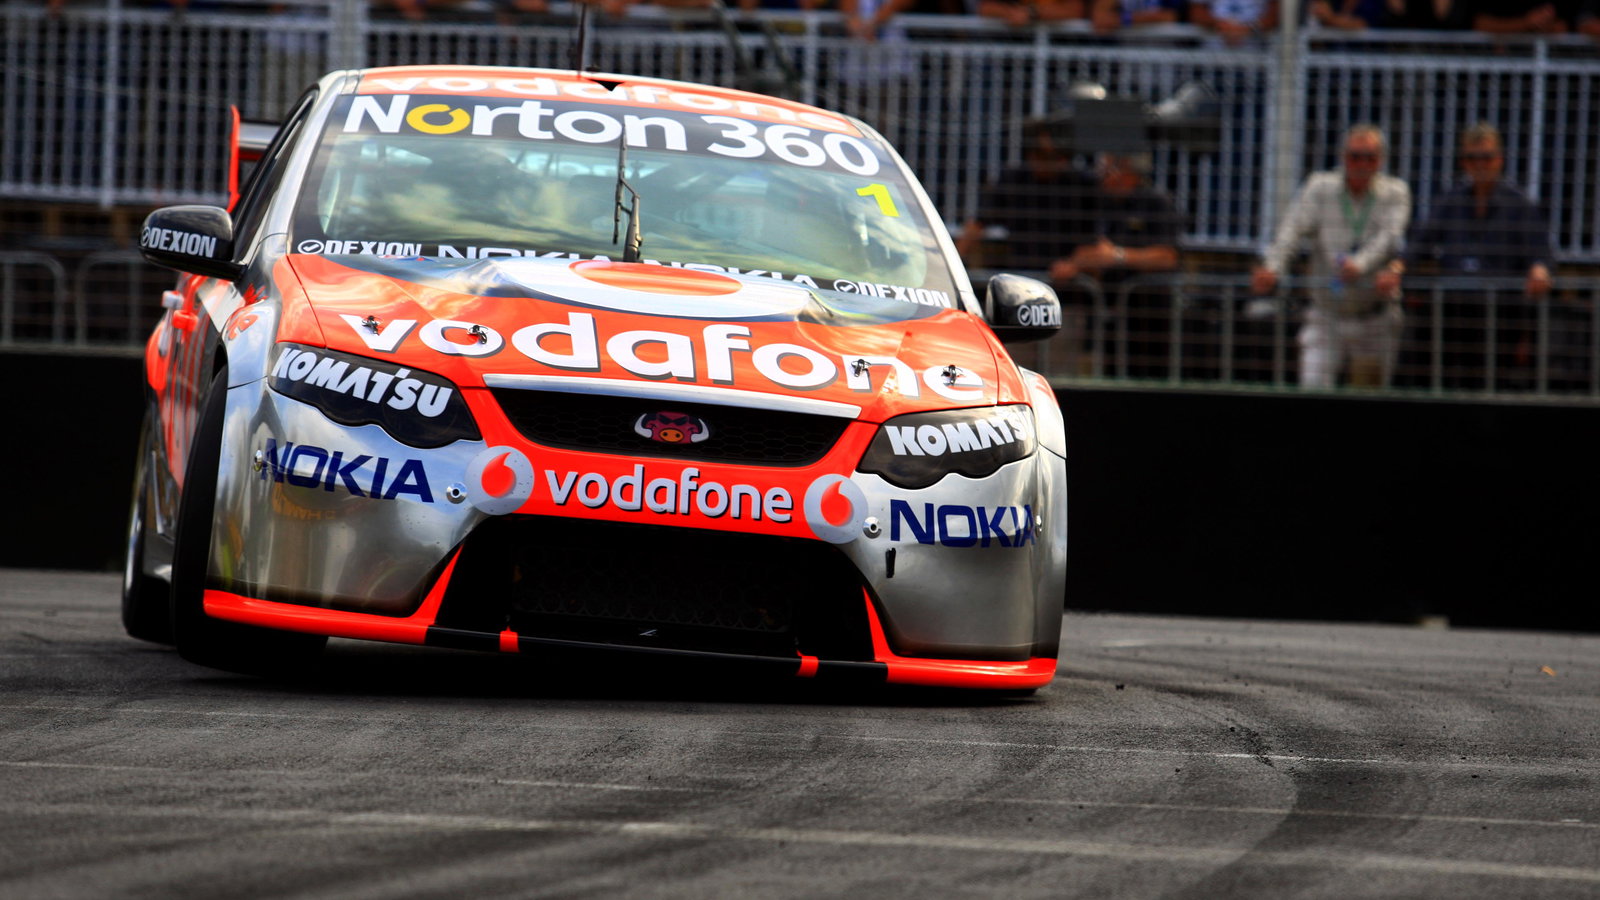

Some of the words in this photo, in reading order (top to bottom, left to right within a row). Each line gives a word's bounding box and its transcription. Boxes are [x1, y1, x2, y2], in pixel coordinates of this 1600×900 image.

[343, 94, 688, 151] Norton
[700, 115, 880, 176] 360
[856, 184, 900, 217] 1
[151, 228, 217, 258] DEXION
[324, 240, 422, 255] DEXION
[857, 282, 952, 308] DEXION
[338, 312, 986, 401] vodafone
[260, 438, 435, 503] NOKIA
[544, 464, 793, 522] vodafone
[890, 499, 1036, 548] NOKIA
